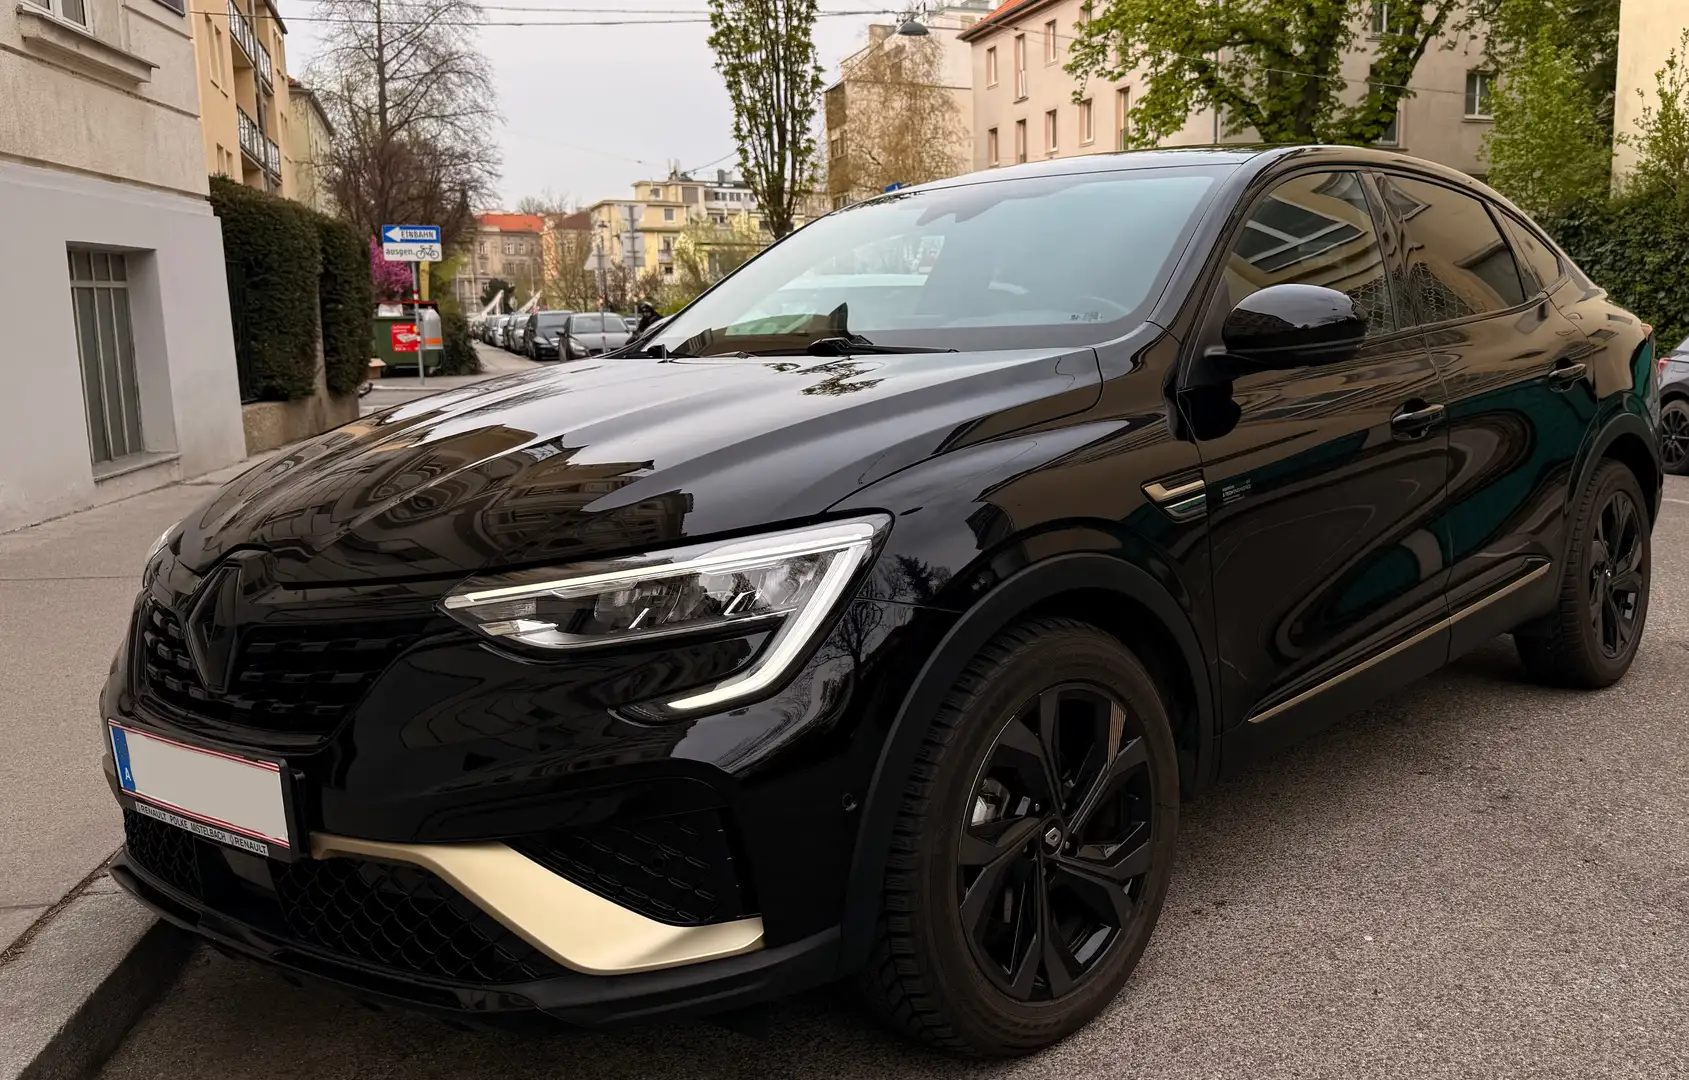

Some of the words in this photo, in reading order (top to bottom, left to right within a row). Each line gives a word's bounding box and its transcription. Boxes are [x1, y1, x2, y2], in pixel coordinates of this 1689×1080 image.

[401, 230, 433, 238] EINBAHN
[386, 248, 415, 257] ausgen.
[124, 767, 132, 781] A
[140, 804, 166, 820] RENAULT
[169, 814, 189, 829] POLKE
[190, 822, 226, 841] MISTELBACH
[235, 838, 267, 854] RENAULT
